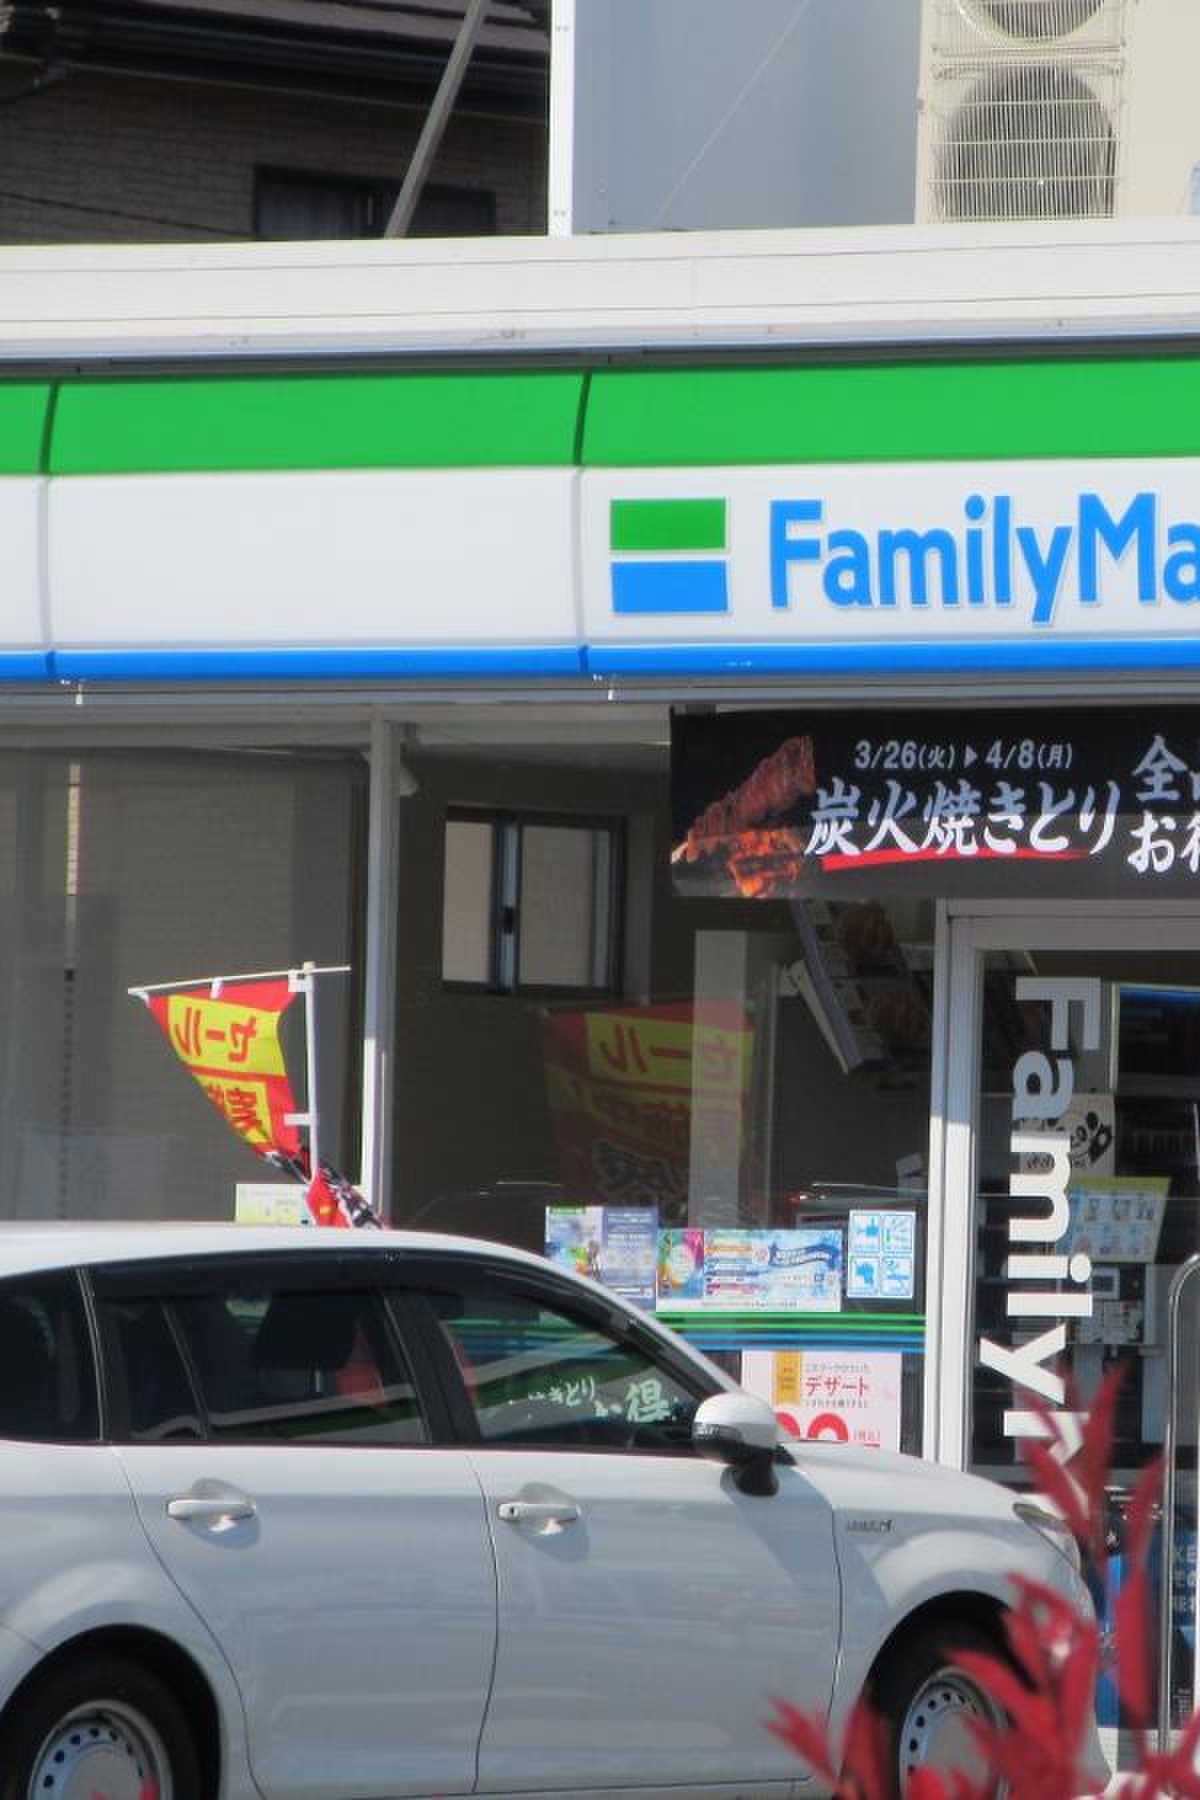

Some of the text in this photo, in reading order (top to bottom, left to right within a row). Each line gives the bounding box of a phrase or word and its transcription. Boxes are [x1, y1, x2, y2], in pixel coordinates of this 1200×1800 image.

[854, 739, 1073, 770] 3/26(火) 4/8(月)
[803, 778, 1122, 856] 炭火焼きとり
[805, 1375, 870, 1397] デザート
